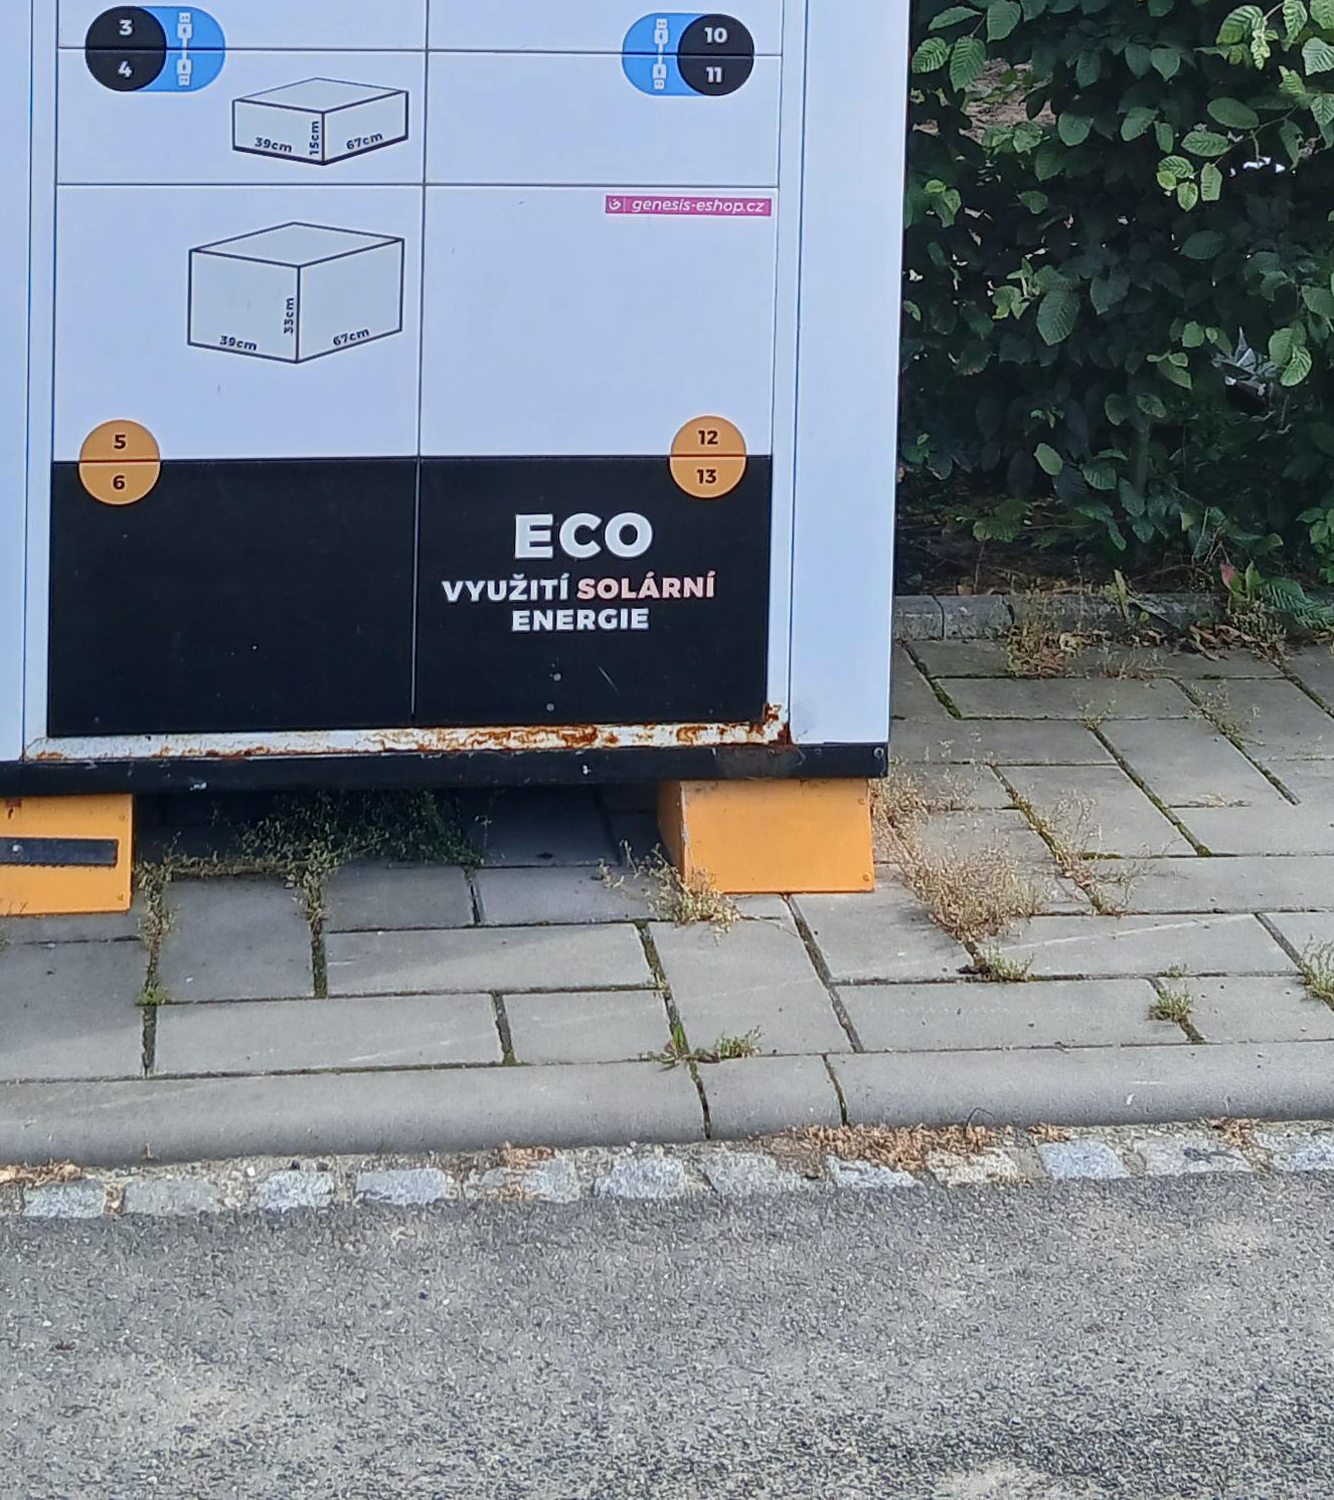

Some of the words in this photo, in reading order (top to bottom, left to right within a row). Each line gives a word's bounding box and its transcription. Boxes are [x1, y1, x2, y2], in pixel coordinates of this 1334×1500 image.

[119, 19, 133, 35] 3
[704, 27, 728, 43] 10
[118, 61, 133, 78] 4
[706, 67, 723, 83] 11
[254, 137, 293, 153] 39cm
[309, 120, 320, 156] 15cm
[346, 131, 383, 151] 67cm
[631, 199, 764, 215] genesis-eshop.cz
[219, 335, 257, 351] 39cm
[333, 327, 370, 347] 67cm
[114, 435, 126, 449] 5
[698, 430, 719, 445] 12
[113, 475, 125, 490] 6
[696, 469, 717, 484] 13
[515, 512, 653, 559] ECO
[441, 573, 570, 603] VYUŽITÍ
[575, 571, 717, 600] SOLÁRNÍ
[512, 608, 650, 632] ENERGIE
